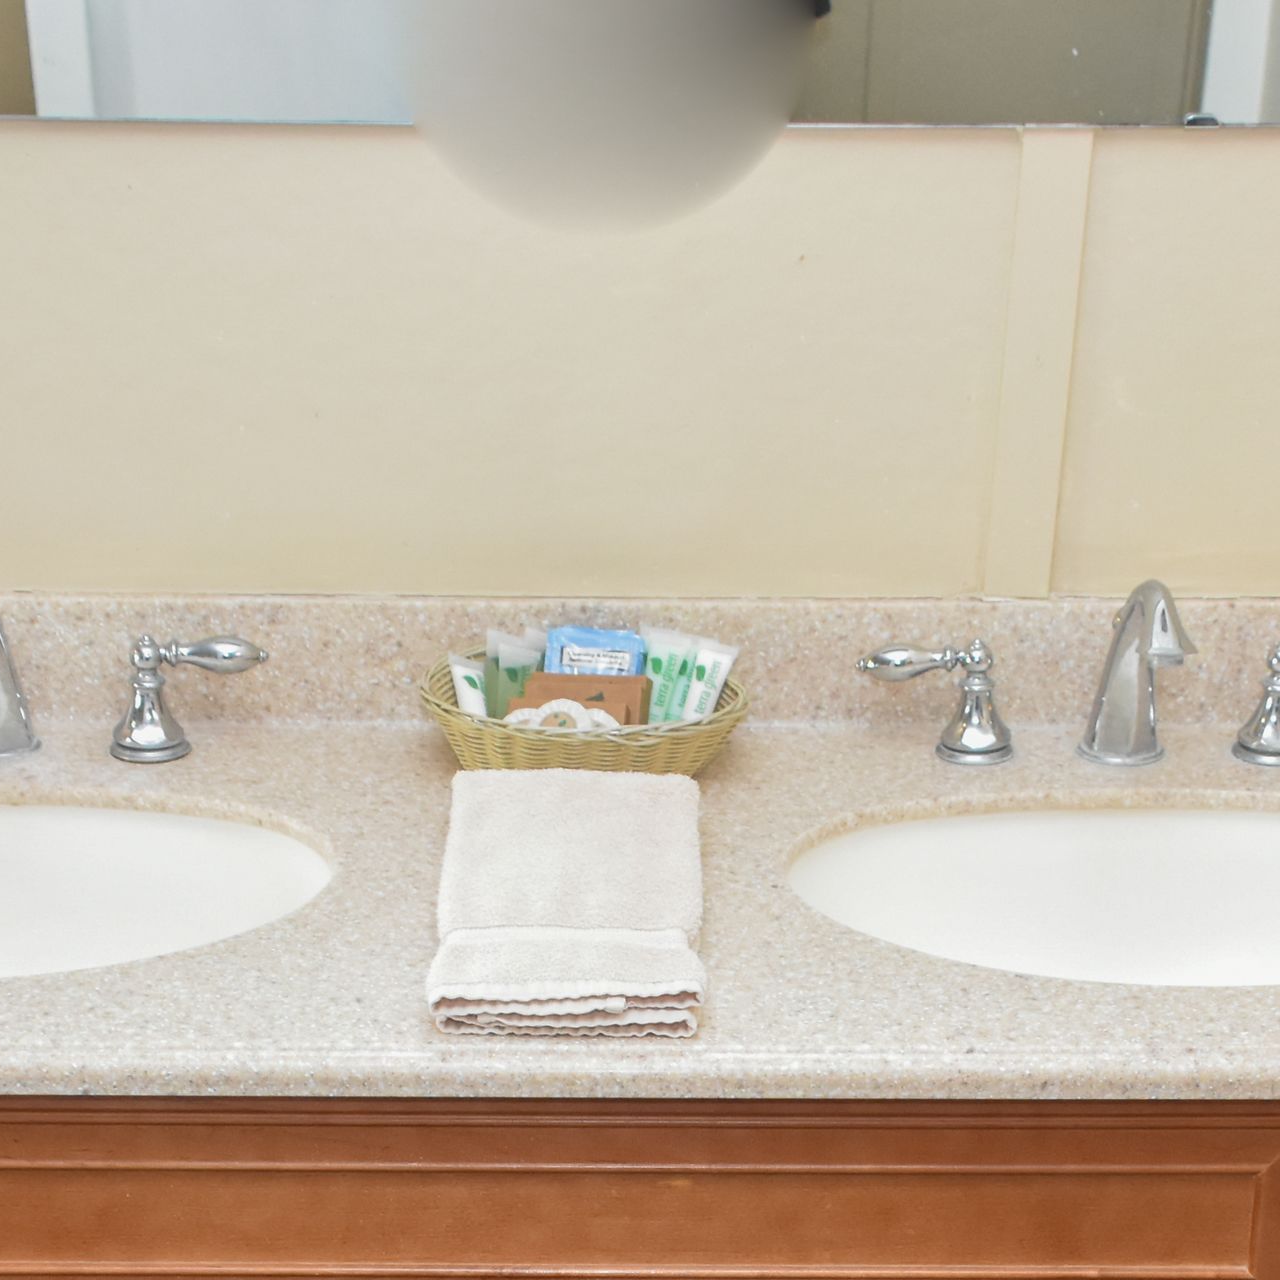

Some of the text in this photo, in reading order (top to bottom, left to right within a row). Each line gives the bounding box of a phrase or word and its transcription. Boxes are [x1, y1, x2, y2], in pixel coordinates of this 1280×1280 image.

[655, 682, 669, 707] terra
[662, 654, 677, 682] green
[695, 661, 722, 714] terra green
